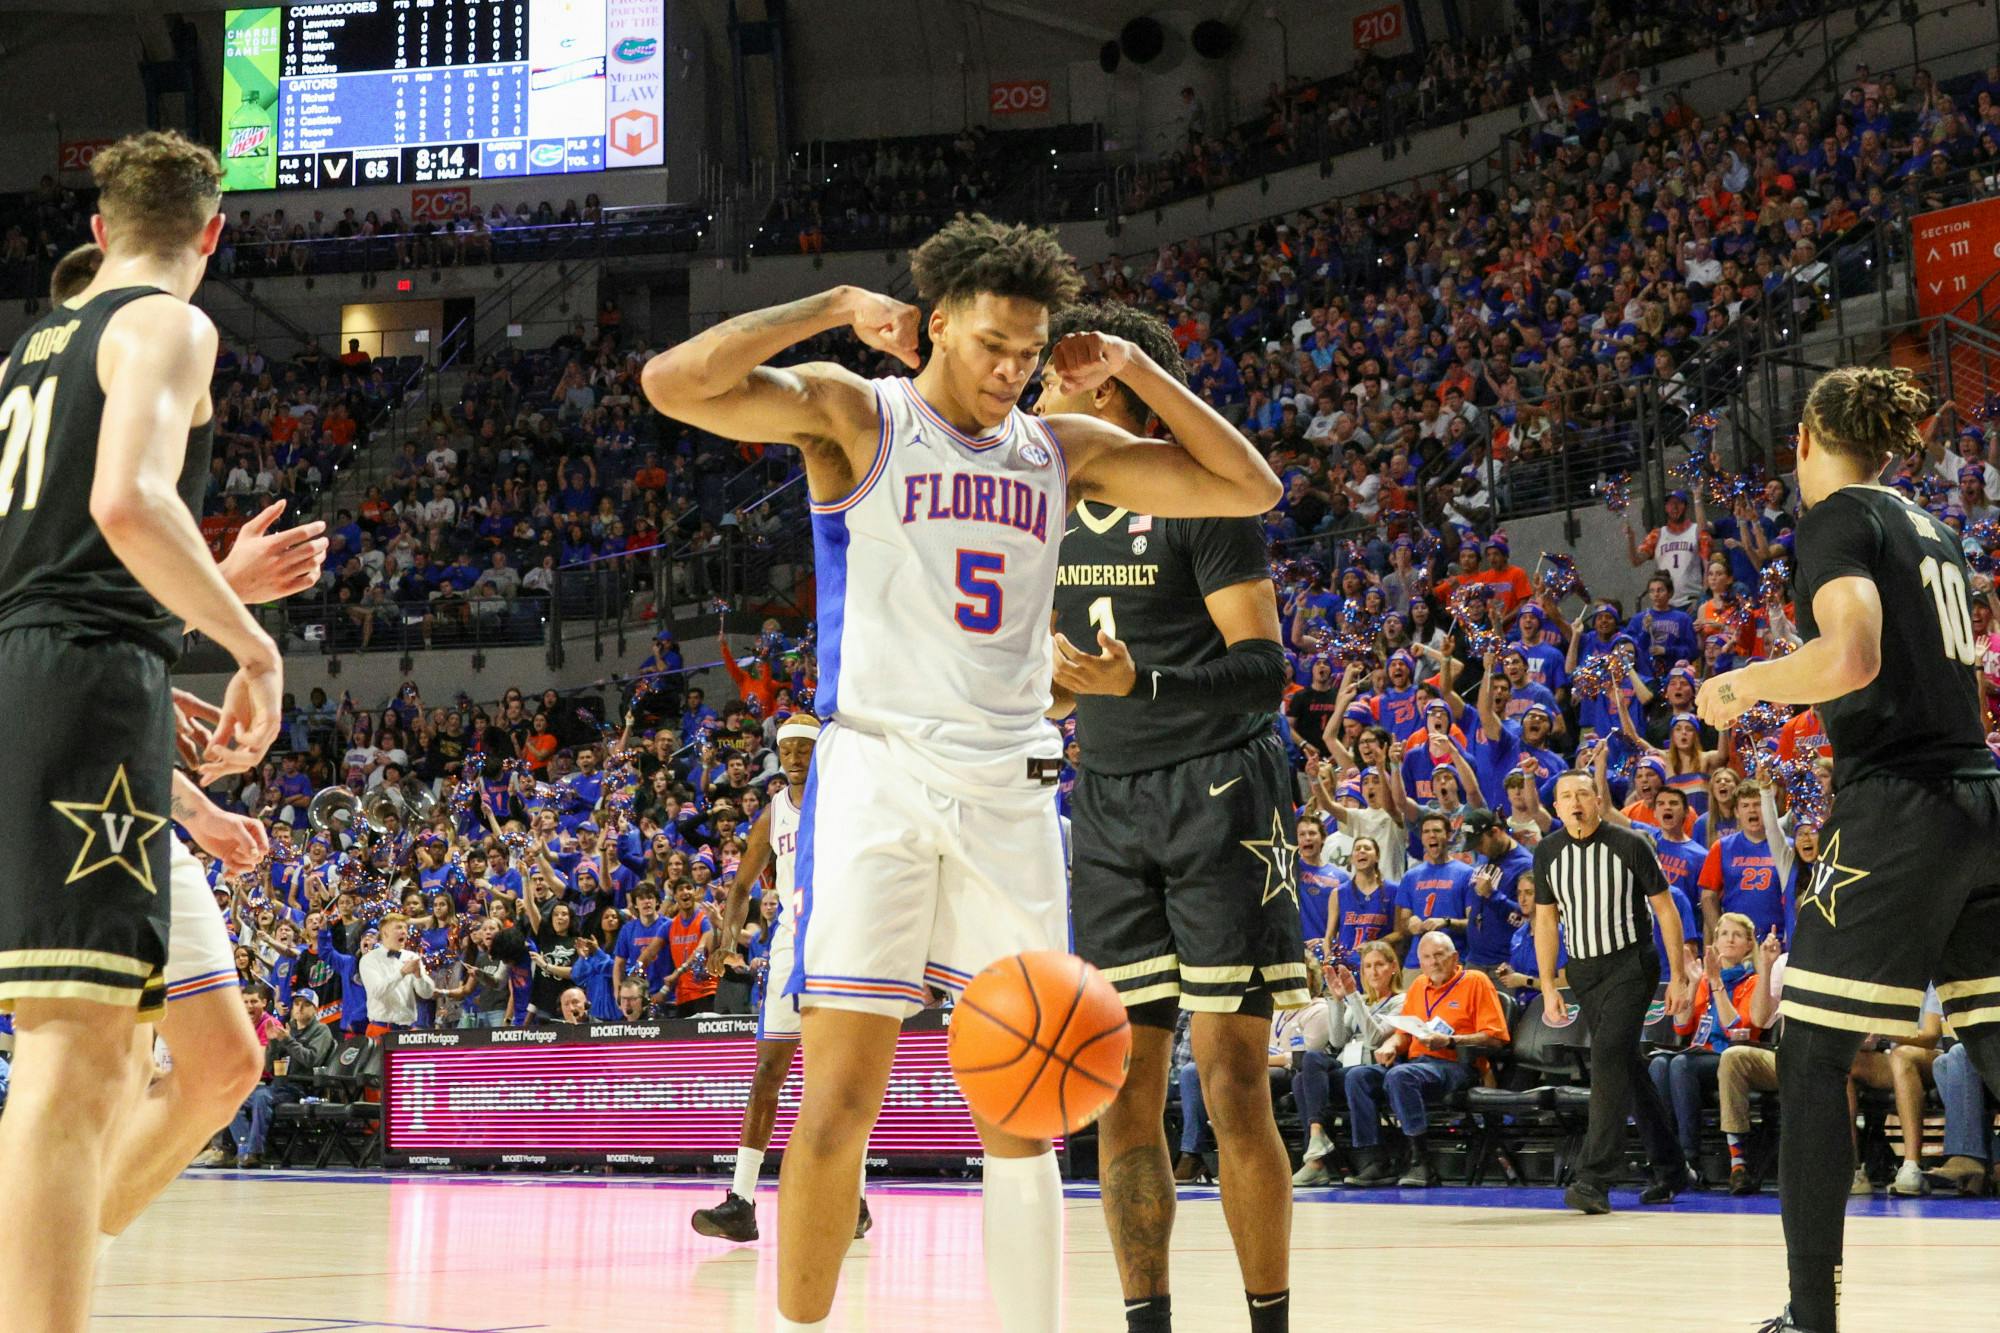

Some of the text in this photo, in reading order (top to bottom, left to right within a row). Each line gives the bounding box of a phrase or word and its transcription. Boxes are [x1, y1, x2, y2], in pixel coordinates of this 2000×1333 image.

[290, 1, 377, 18] COMMODORES
[469, 8, 476, 18] 0
[493, 6, 500, 16] 0
[515, 4, 522, 15] 0
[421, 22, 428, 32] 0
[468, 19, 476, 30] 0
[493, 18, 500, 28] 0
[515, 16, 522, 26] 0
[1358, 12, 1396, 43] 210
[421, 34, 428, 44] 2
[493, 29, 500, 40] 0
[515, 28, 522, 38] 0
[227, 48, 260, 57] GAME
[445, 55, 452, 66] 0
[468, 54, 476, 64] 0
[289, 78, 338, 92] GATORS
[444, 84, 452, 94] 0
[468, 82, 475, 92] 0
[492, 80, 500, 91] 0
[610, 84, 658, 102] LAW
[468, 94, 475, 104] 0
[492, 92, 500, 102] 0
[994, 86, 1046, 110] 209
[467, 105, 474, 116] 0
[444, 118, 451, 129] 0
[492, 116, 499, 126] 0
[466, 128, 474, 139] 0
[492, 127, 499, 138] 0
[514, 126, 521, 136] 0
[592, 138, 600, 149] 4
[416, 146, 465, 170] 8:14
[494, 152, 518, 171] 61
[323, 158, 348, 179] V
[365, 160, 388, 178] 65
[437, 168, 464, 180] HALF
[279, 174, 300, 184] TOL
[1920, 221, 1971, 239] SECTION
[1950, 240, 1969, 256] 111
[1954, 276, 1966, 292] 11
[0, 375, 58, 516] 21
[903, 472, 1048, 544] FLORIDA
[1661, 541, 1695, 556] FLORIDA
[1672, 554, 1679, 568] 1
[1056, 564, 1158, 586] ANDERBILT
[954, 548, 1005, 635] 5
[1919, 555, 1976, 666] 10
[1088, 596, 1117, 657] 1
[102, 812, 135, 854] V
[1272, 847, 1287, 880] V
[1740, 868, 1772, 890] 23
[1814, 862, 1834, 894] V
[1424, 892, 1436, 917] 1
[590, 1025, 660, 1038] ROCKET Mortgage
[698, 1021, 758, 1034] ROCKET Mortg
[398, 1033, 459, 1046] ROCKET Mortgage
[492, 1031, 558, 1043] ROCKET Mortgage
